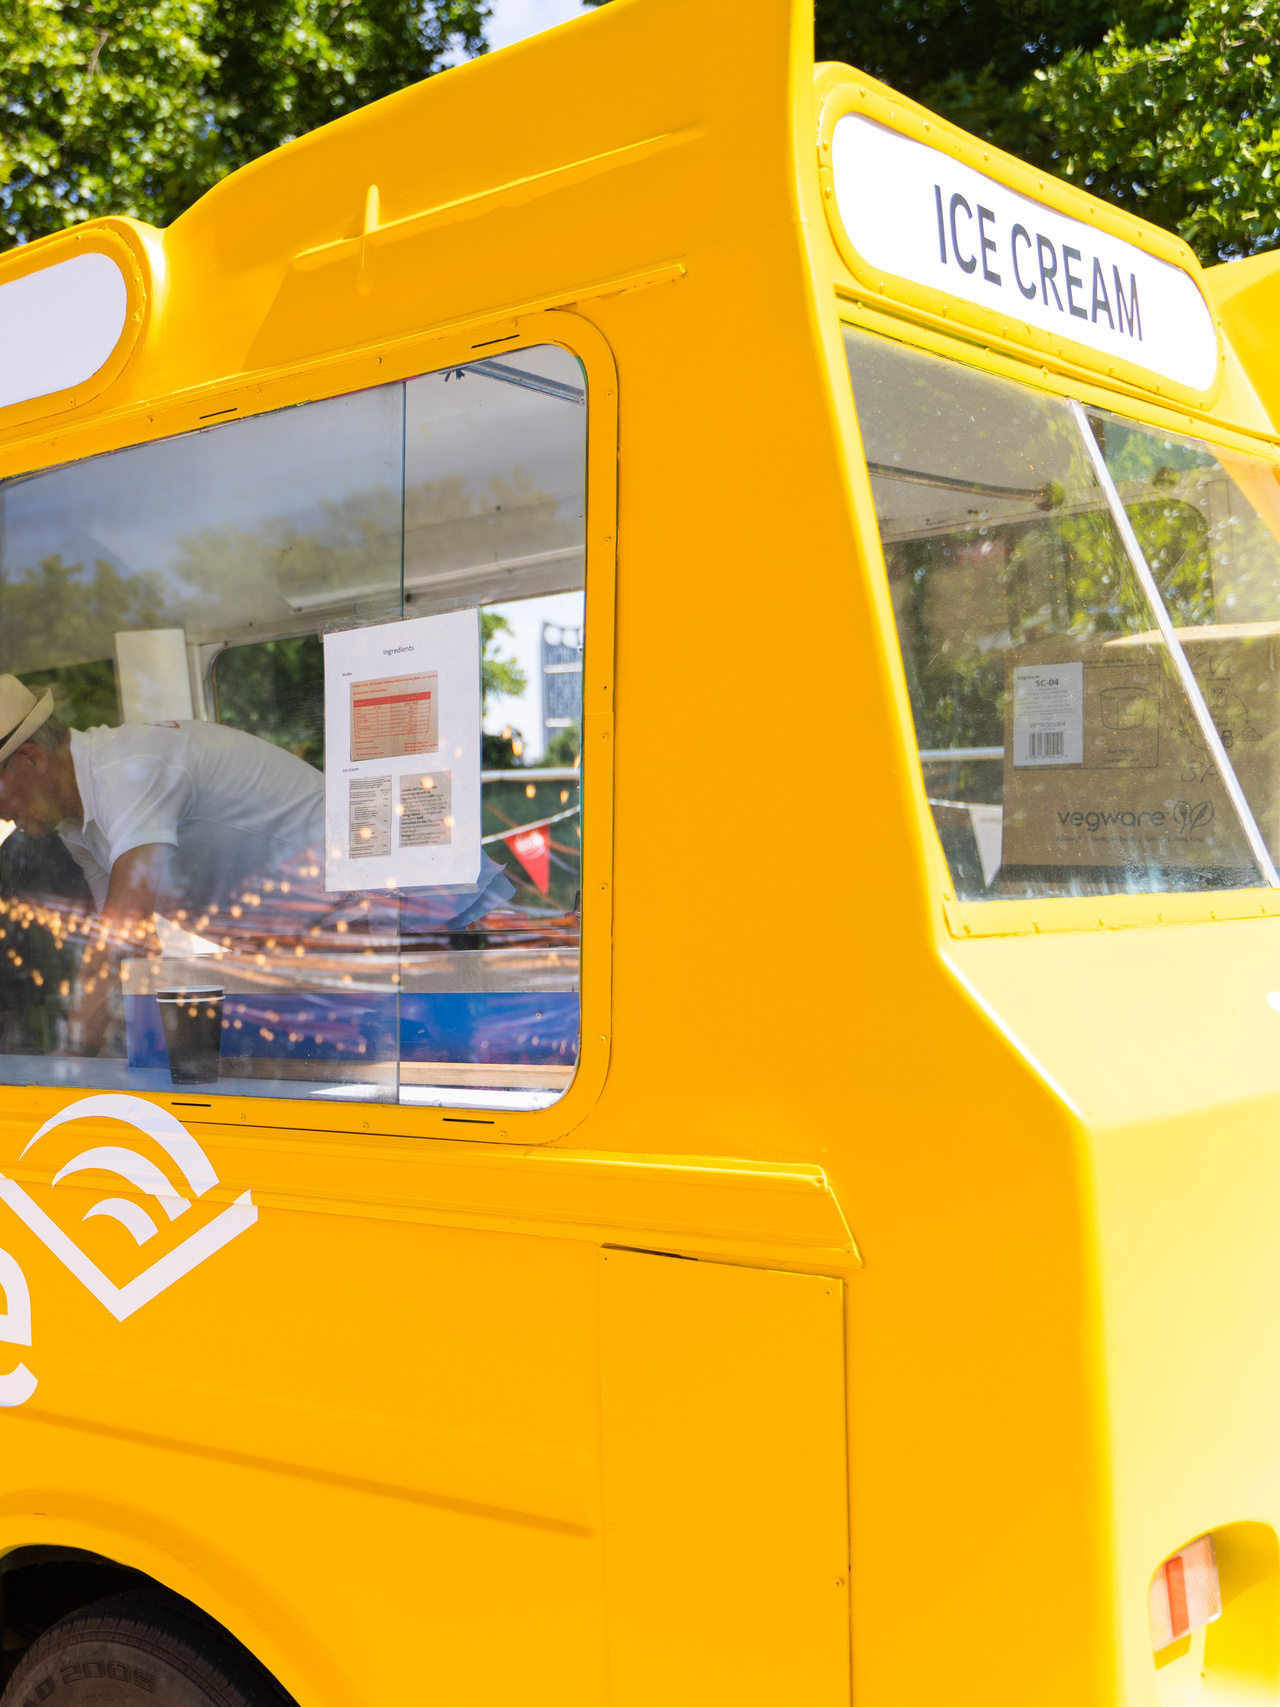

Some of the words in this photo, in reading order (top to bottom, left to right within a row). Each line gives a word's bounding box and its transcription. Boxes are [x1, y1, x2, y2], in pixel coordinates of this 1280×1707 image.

[934, 184, 1002, 287] ICE
[1010, 223, 1143, 342] CREAM
[382, 645, 414, 656] Ingredients
[1035, 678, 1059, 687] SC-04
[1057, 810, 1166, 832] vegware
